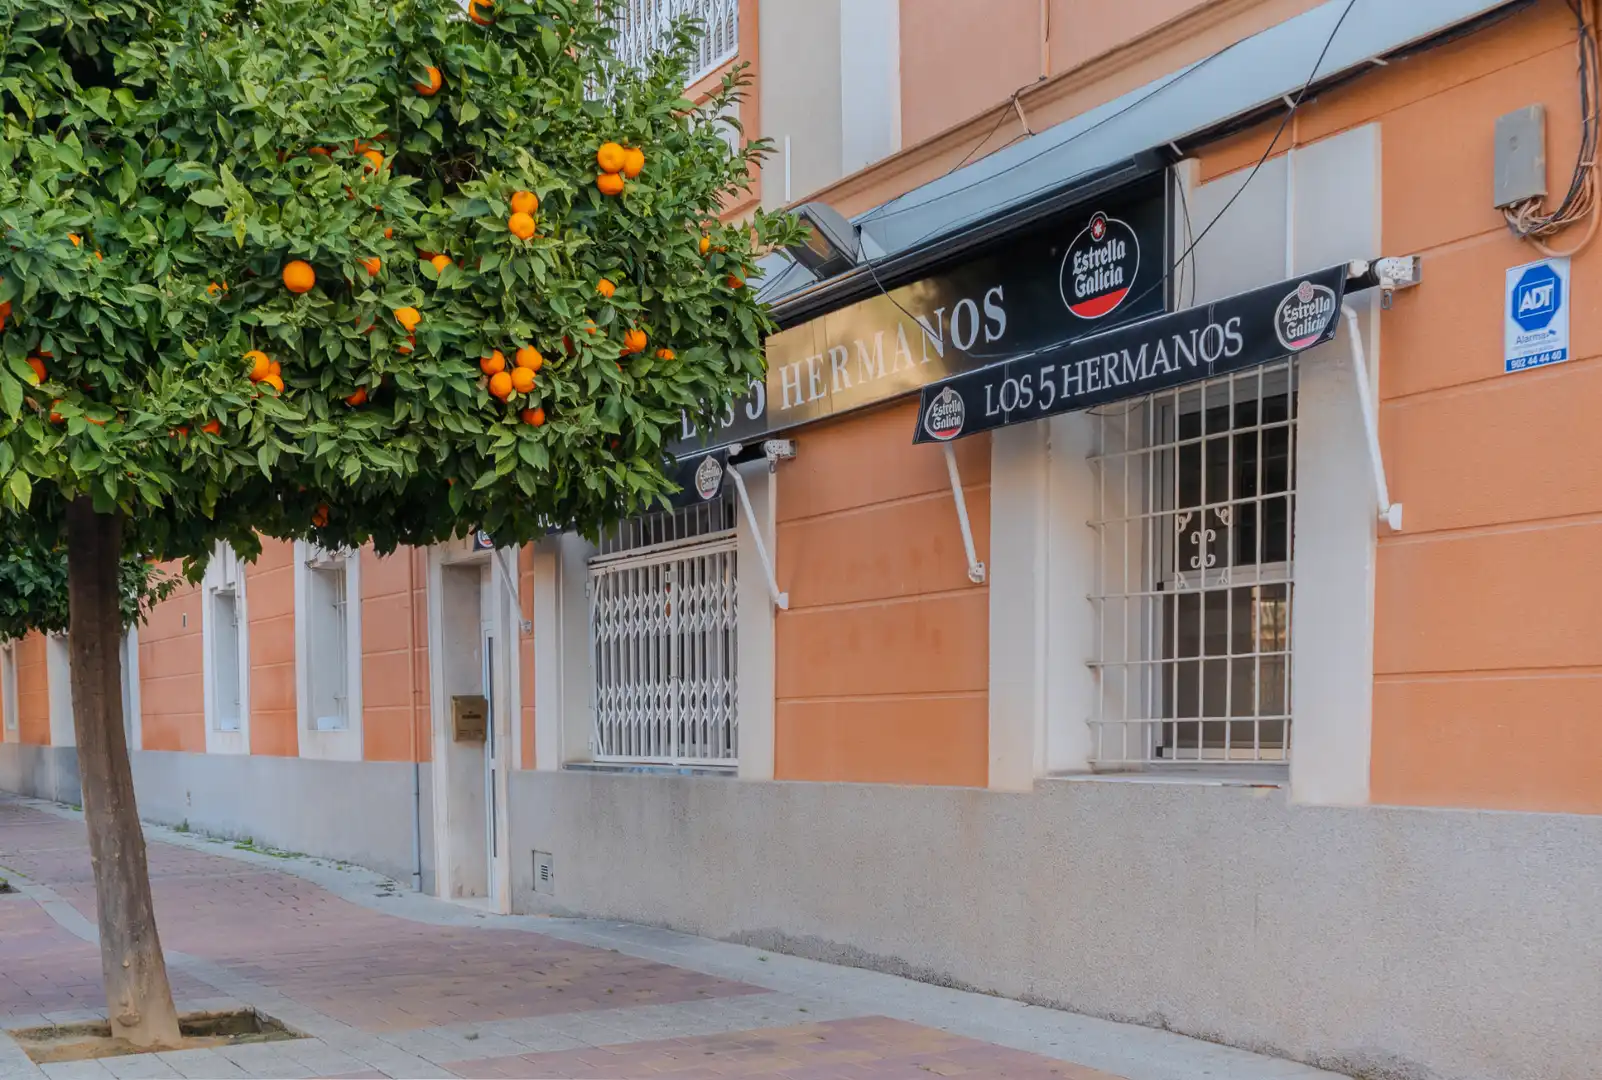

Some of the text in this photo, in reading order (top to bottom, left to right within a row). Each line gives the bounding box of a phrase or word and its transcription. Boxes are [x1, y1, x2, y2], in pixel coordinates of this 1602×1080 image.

[1072, 238, 1126, 276] Estrella
[1075, 263, 1123, 298] Galicia
[1283, 296, 1331, 324] Estrella
[1518, 283, 1554, 313] ADT
[1286, 314, 1326, 340] Galicia
[779, 285, 1008, 411] HERMANOS
[984, 316, 1244, 417] LOS 5 HERMANOS
[932, 399, 962, 418] Estrella
[933, 413, 961, 430] Galicia
